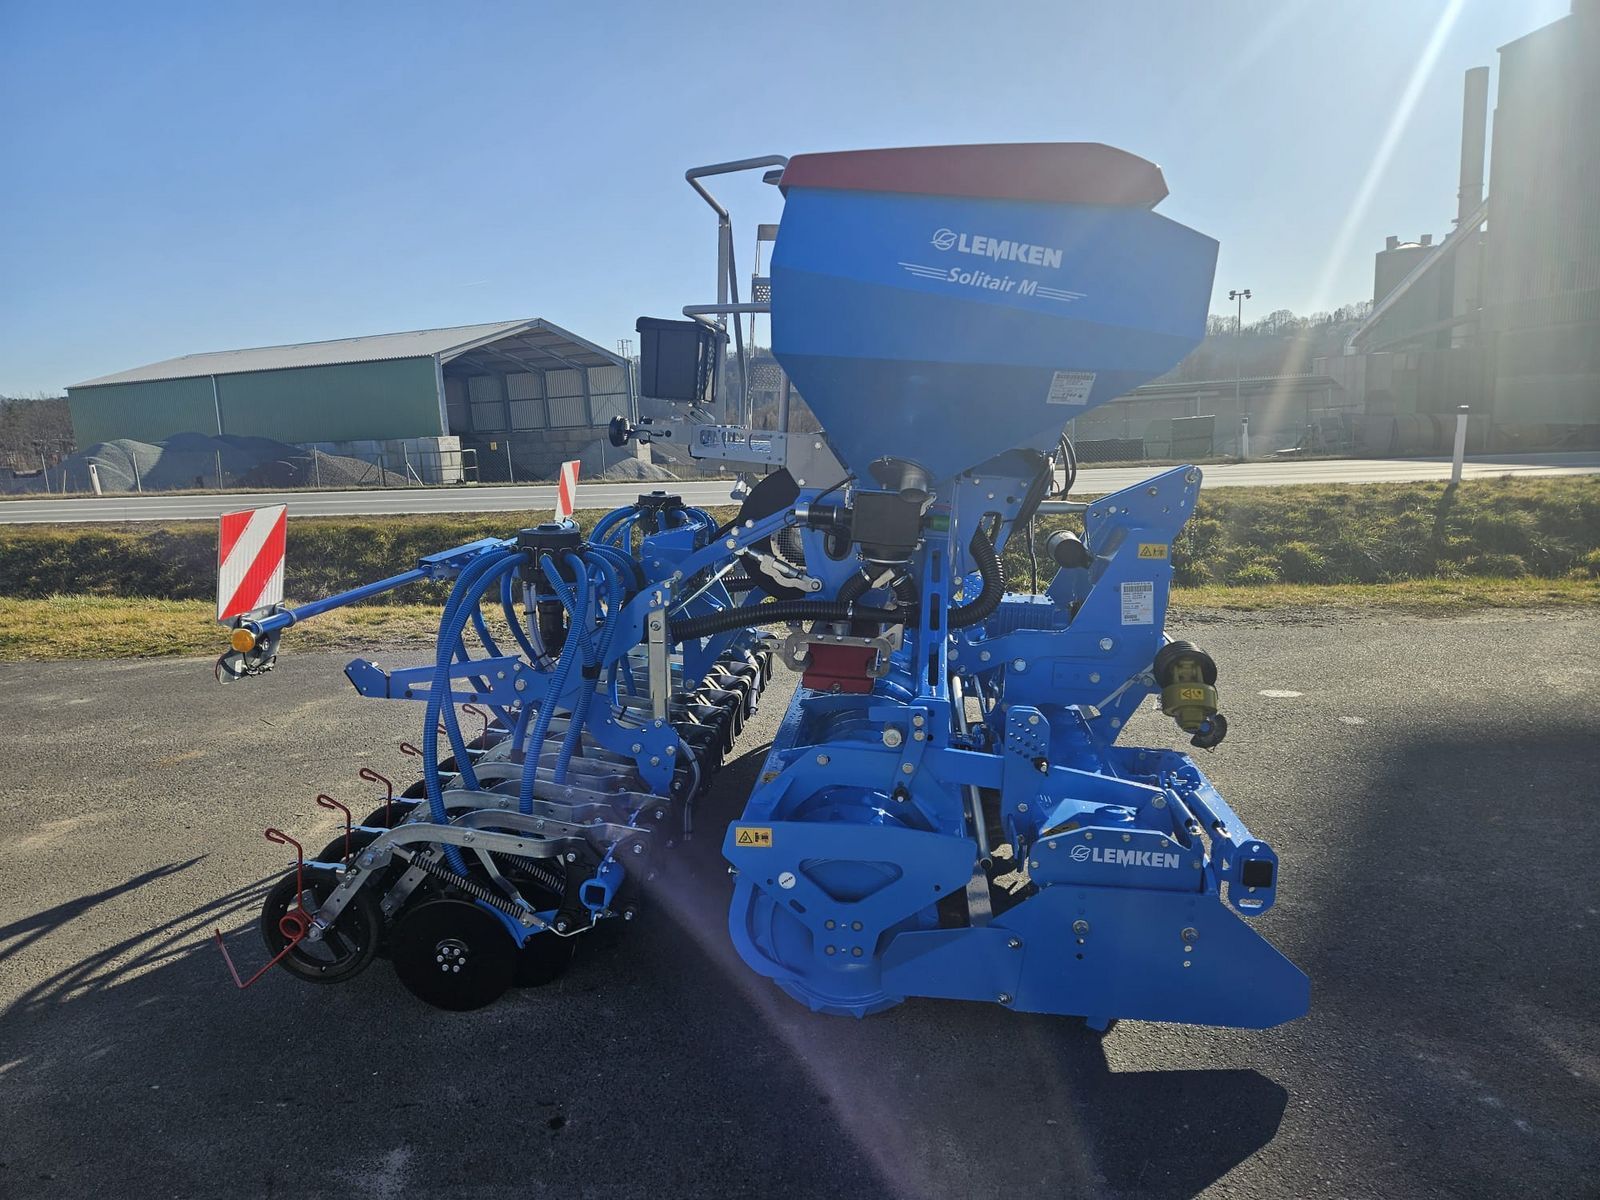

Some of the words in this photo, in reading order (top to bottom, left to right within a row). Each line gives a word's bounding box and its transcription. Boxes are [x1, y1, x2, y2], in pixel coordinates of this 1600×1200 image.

[957, 233, 1063, 268] LEMKEN
[947, 267, 1015, 292] Solitair
[1017, 279, 1038, 296] M
[1092, 847, 1180, 869] LEMKEN
